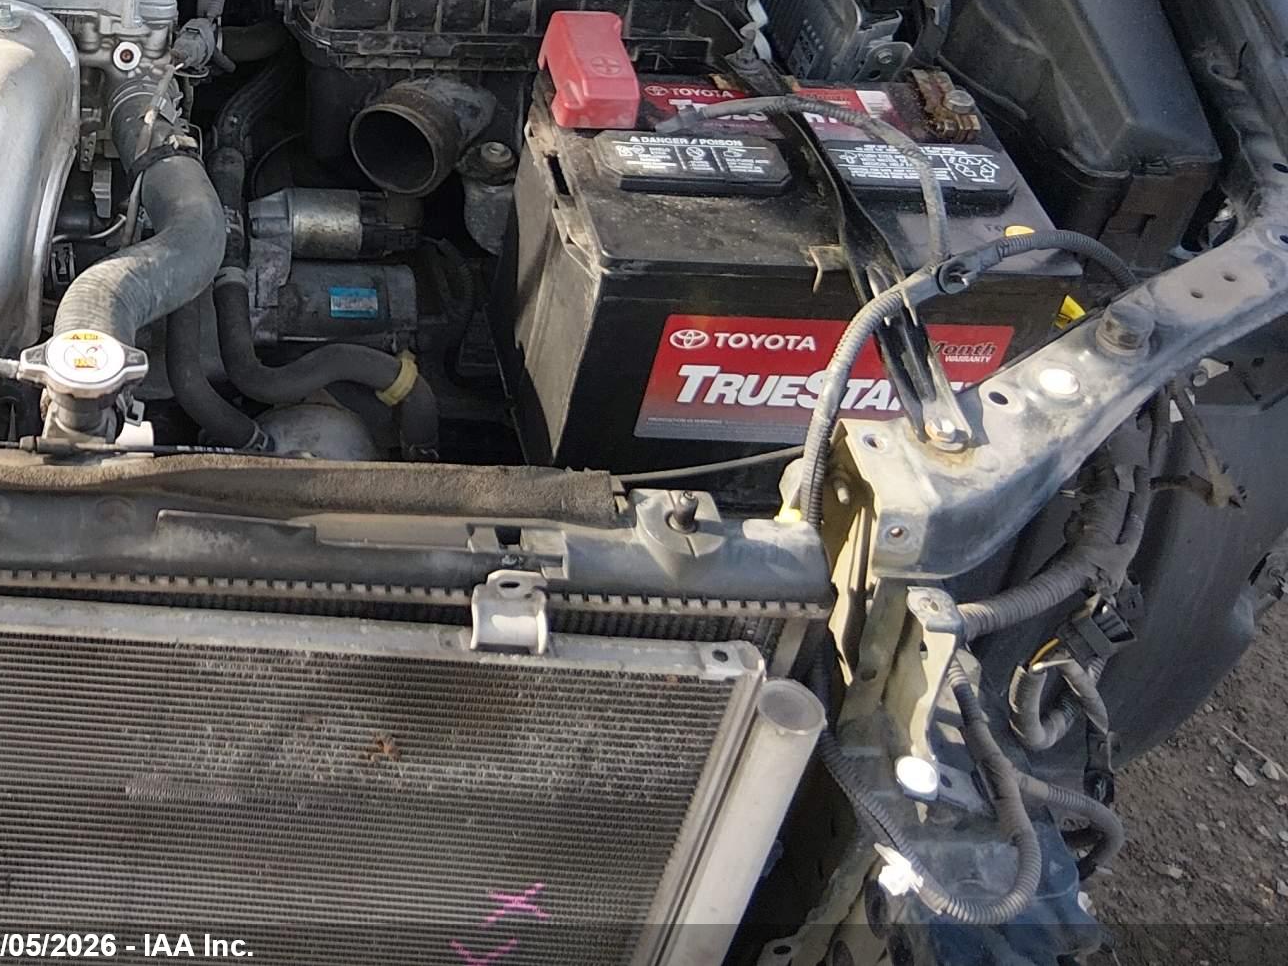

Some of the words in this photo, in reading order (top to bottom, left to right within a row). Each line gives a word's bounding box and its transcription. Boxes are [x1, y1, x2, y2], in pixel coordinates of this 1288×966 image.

[669, 87, 735, 99] TOYOTA
[640, 136, 689, 145] DANGER
[698, 138, 744, 147] POISON
[714, 332, 817, 352] TOYOTA
[944, 354, 992, 363] WARRANTY
[676, 364, 966, 412] TRUESTA
